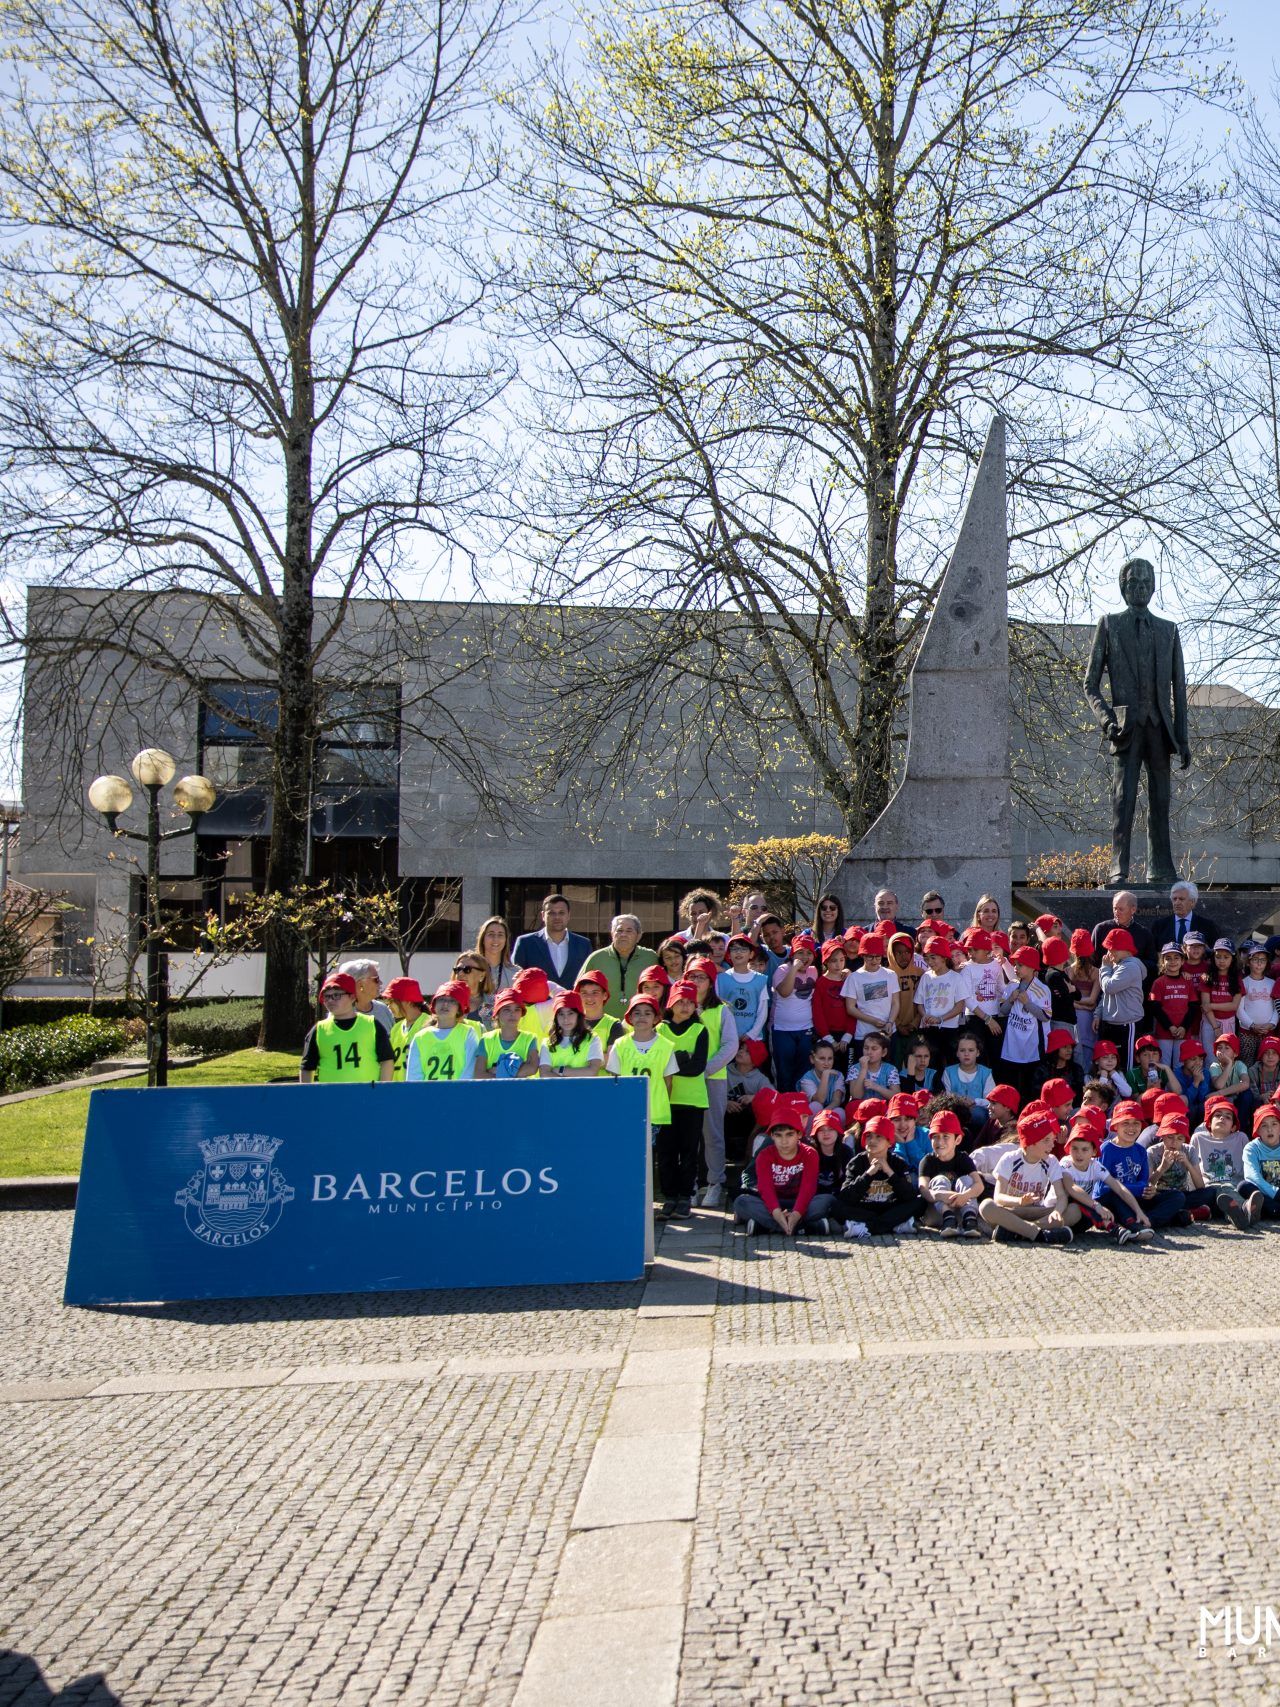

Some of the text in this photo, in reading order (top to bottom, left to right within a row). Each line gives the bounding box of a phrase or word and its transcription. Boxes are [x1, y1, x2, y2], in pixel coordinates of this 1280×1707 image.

[333, 1042, 361, 1070] 14
[427, 1054, 455, 1080] 24
[312, 1167, 559, 1201] BARCELOS
[368, 1199, 503, 1214] MUNICÍPIO
[195, 1221, 270, 1245] BARCELOS
